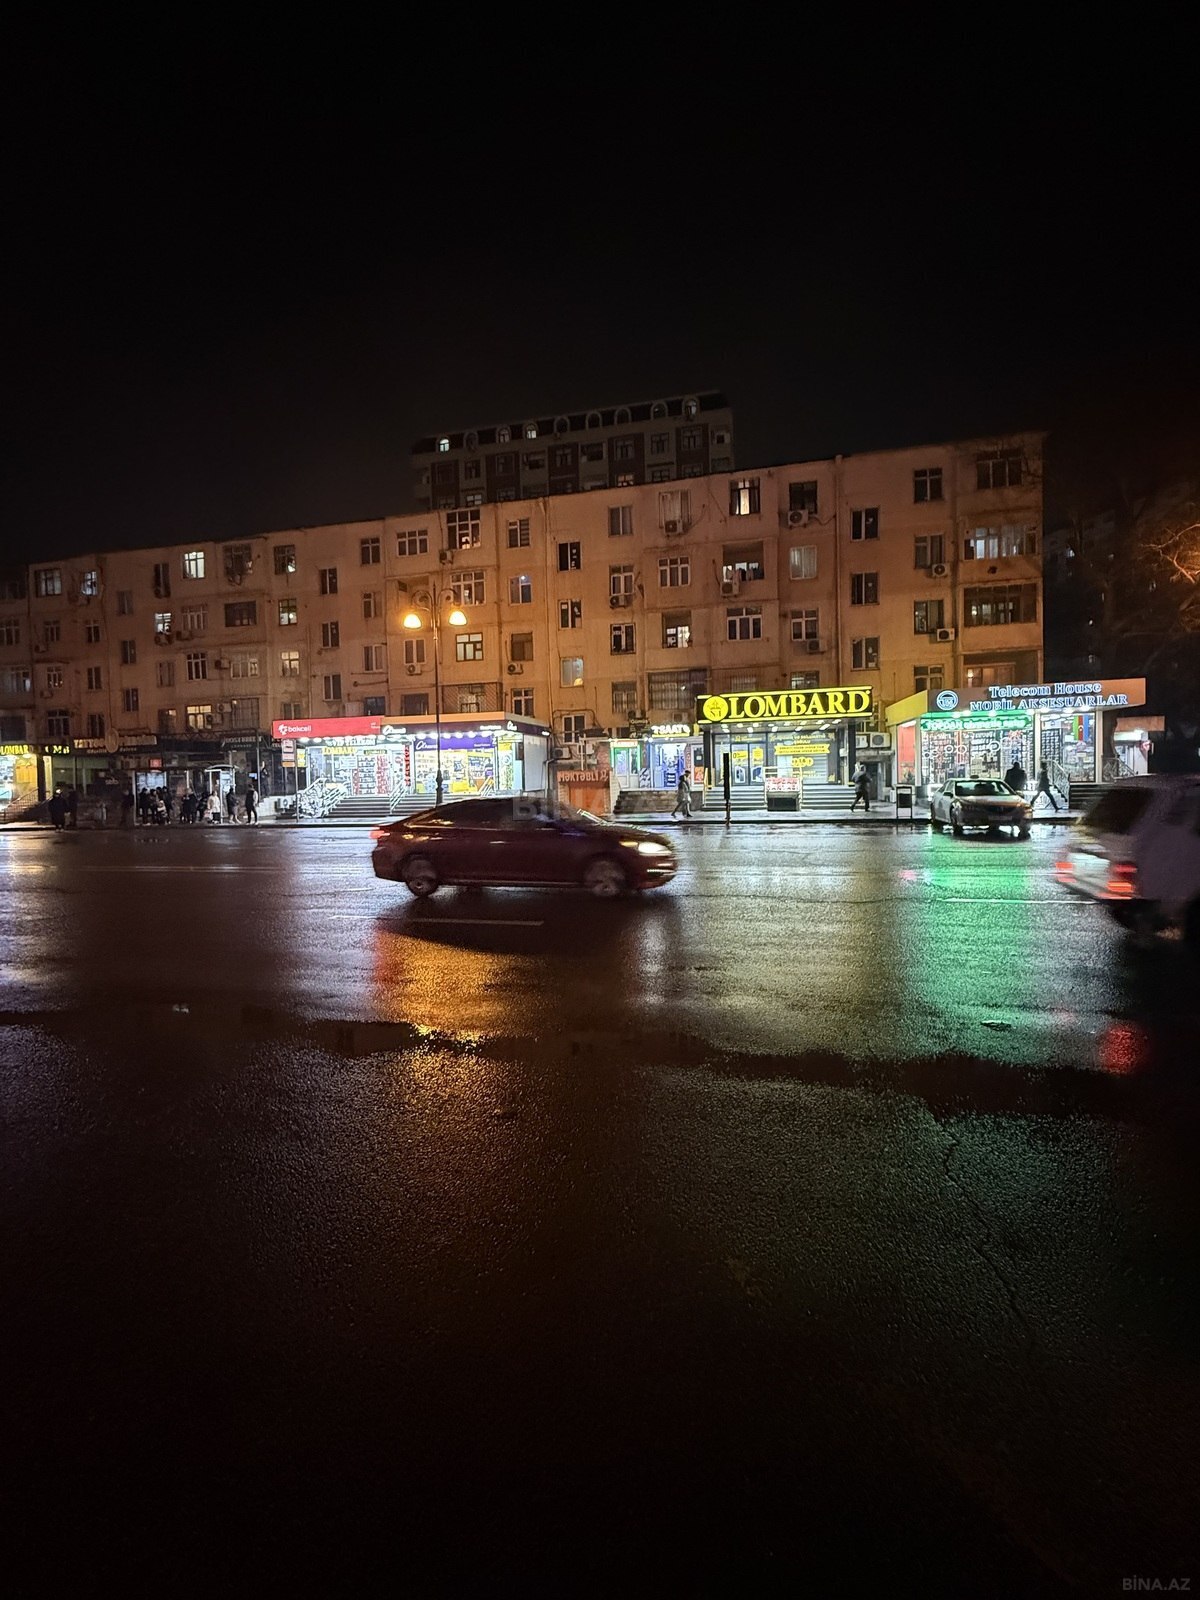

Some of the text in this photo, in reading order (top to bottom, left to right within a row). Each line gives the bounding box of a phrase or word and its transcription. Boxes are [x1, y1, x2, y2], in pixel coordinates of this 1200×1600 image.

[988, 682, 1102, 699] Telecom House
[728, 690, 870, 719] LOMBARD
[1017, 694, 1128, 709] AKSESUARLAR
